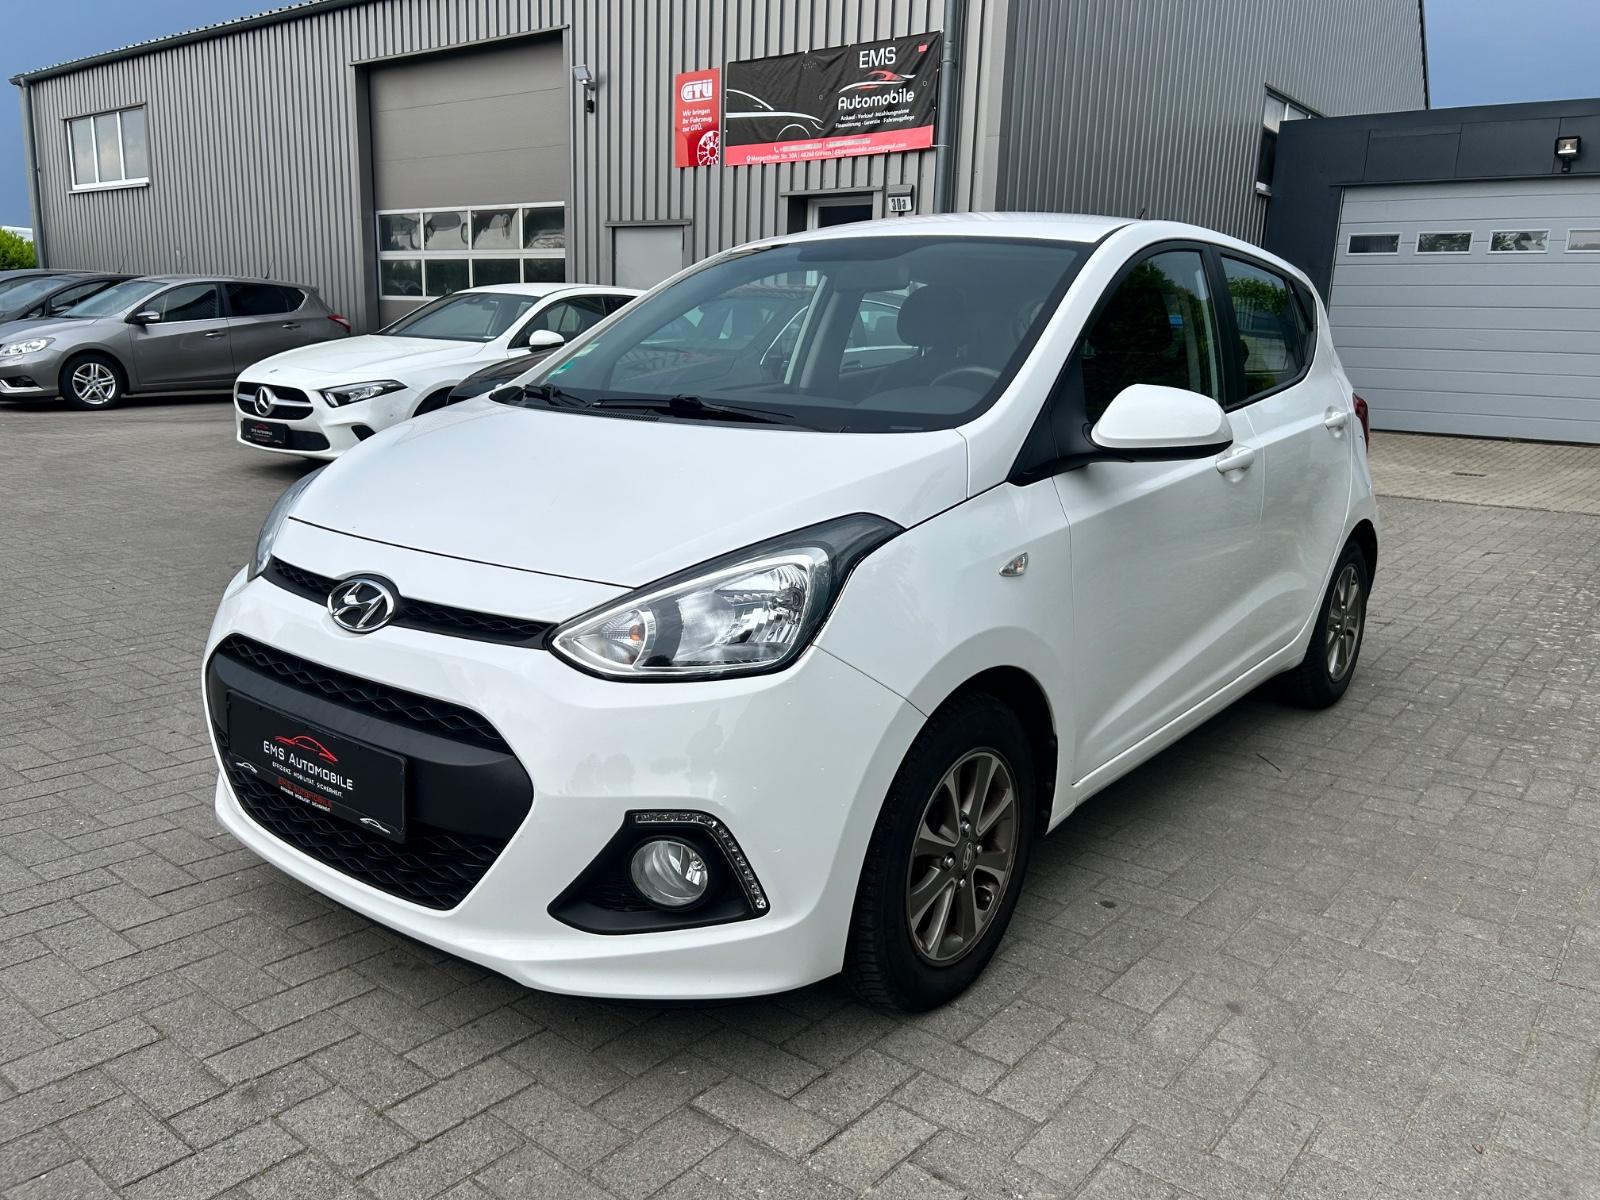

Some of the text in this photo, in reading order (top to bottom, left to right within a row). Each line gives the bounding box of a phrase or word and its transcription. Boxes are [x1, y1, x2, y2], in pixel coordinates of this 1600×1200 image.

[859, 47, 896, 68] EMS
[683, 79, 712, 100] GTÜ
[838, 88, 914, 110] Automobile
[692, 109, 710, 117] bringen
[263, 741, 353, 790] EMS AUTOMOBILE
